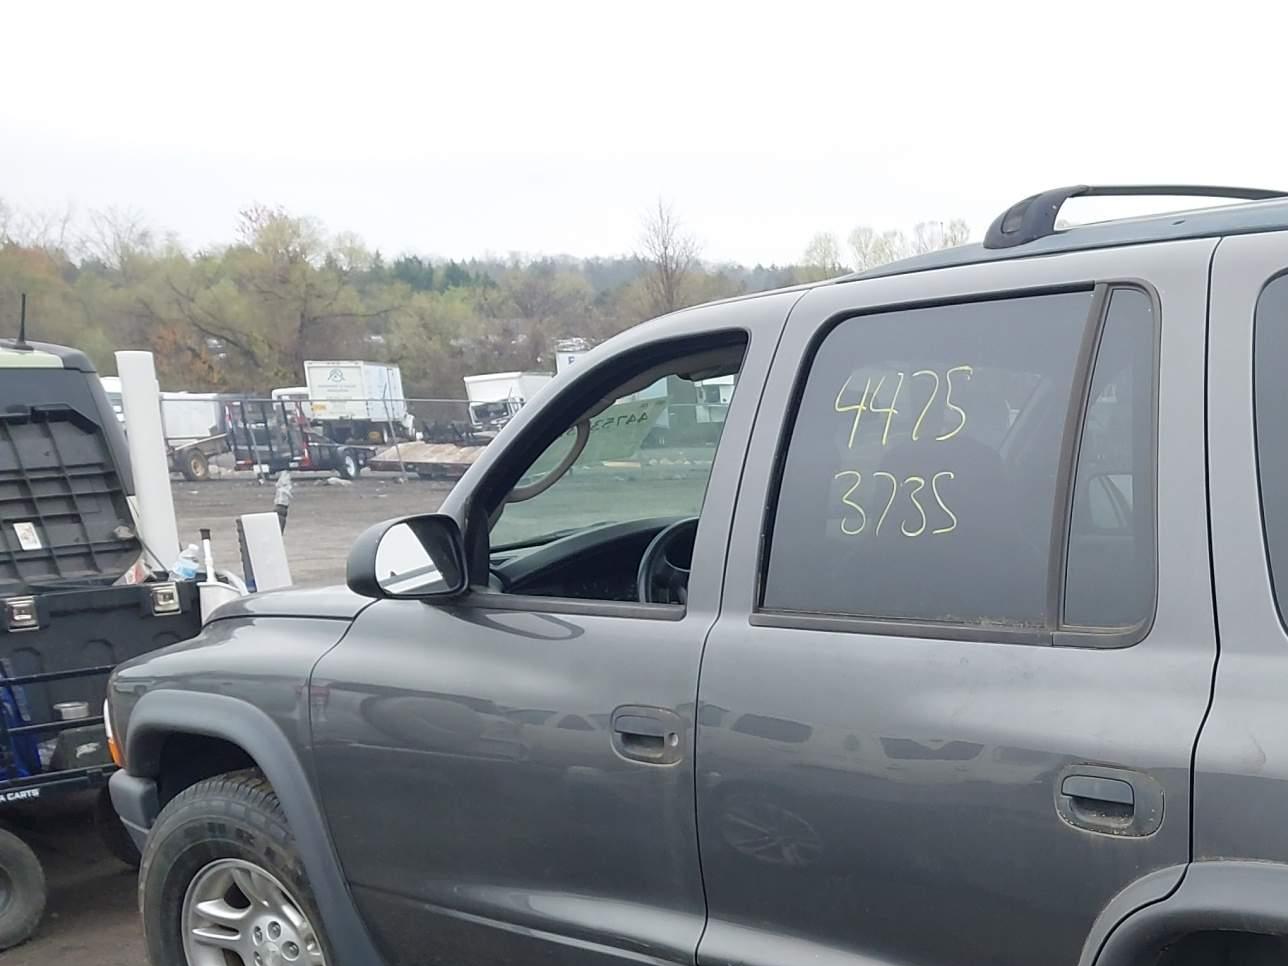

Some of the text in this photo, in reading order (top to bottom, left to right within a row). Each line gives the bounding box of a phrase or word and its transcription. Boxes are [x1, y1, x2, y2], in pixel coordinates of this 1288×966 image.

[834, 365, 973, 449] 4475
[834, 470, 958, 537] 3735
[6, 788, 40, 801] CARTS
